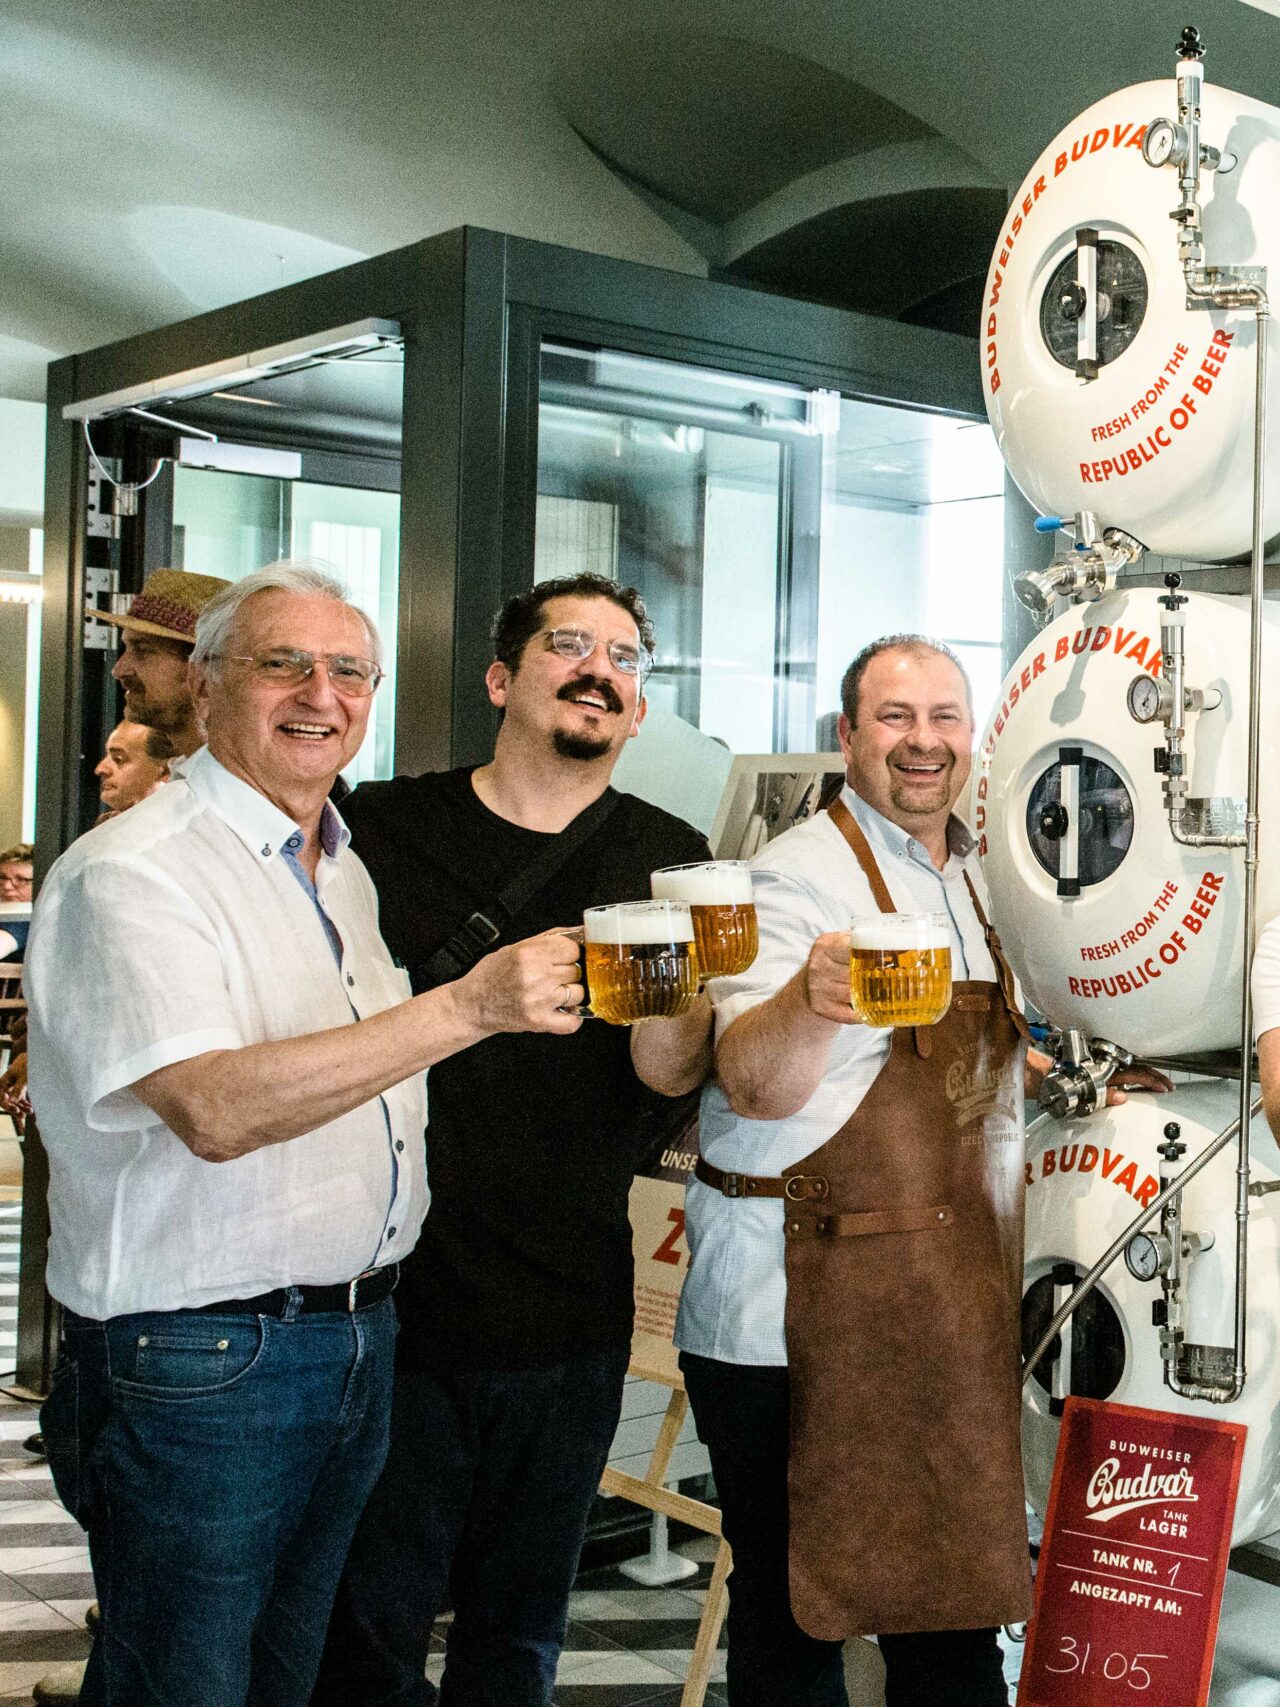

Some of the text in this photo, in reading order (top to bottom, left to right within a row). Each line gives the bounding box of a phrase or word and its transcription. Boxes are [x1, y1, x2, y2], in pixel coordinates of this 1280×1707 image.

[987, 123, 1149, 395] BUDWEISER BUDVA
[1079, 329, 1234, 483] REPUBLIC OF BEER
[1091, 342, 1189, 442] FRESH FROM THE
[1068, 872, 1224, 998] REPUBLIC OF BEER
[1080, 880, 1179, 961] FRESH FROM THE
[661, 1149, 698, 1171] UNSE
[1042, 1144, 1159, 1209] BUDVAR
[1110, 1440, 1191, 1463] BUDWEISER
[1086, 1457, 1199, 1509] Budvar
[1140, 1517, 1188, 1538] LAGER
[1163, 1509, 1188, 1522] TANK
[1093, 1549, 1181, 1586] TANK NR. 1
[1070, 1580, 1182, 1616] ANGEZAPFT AM:
